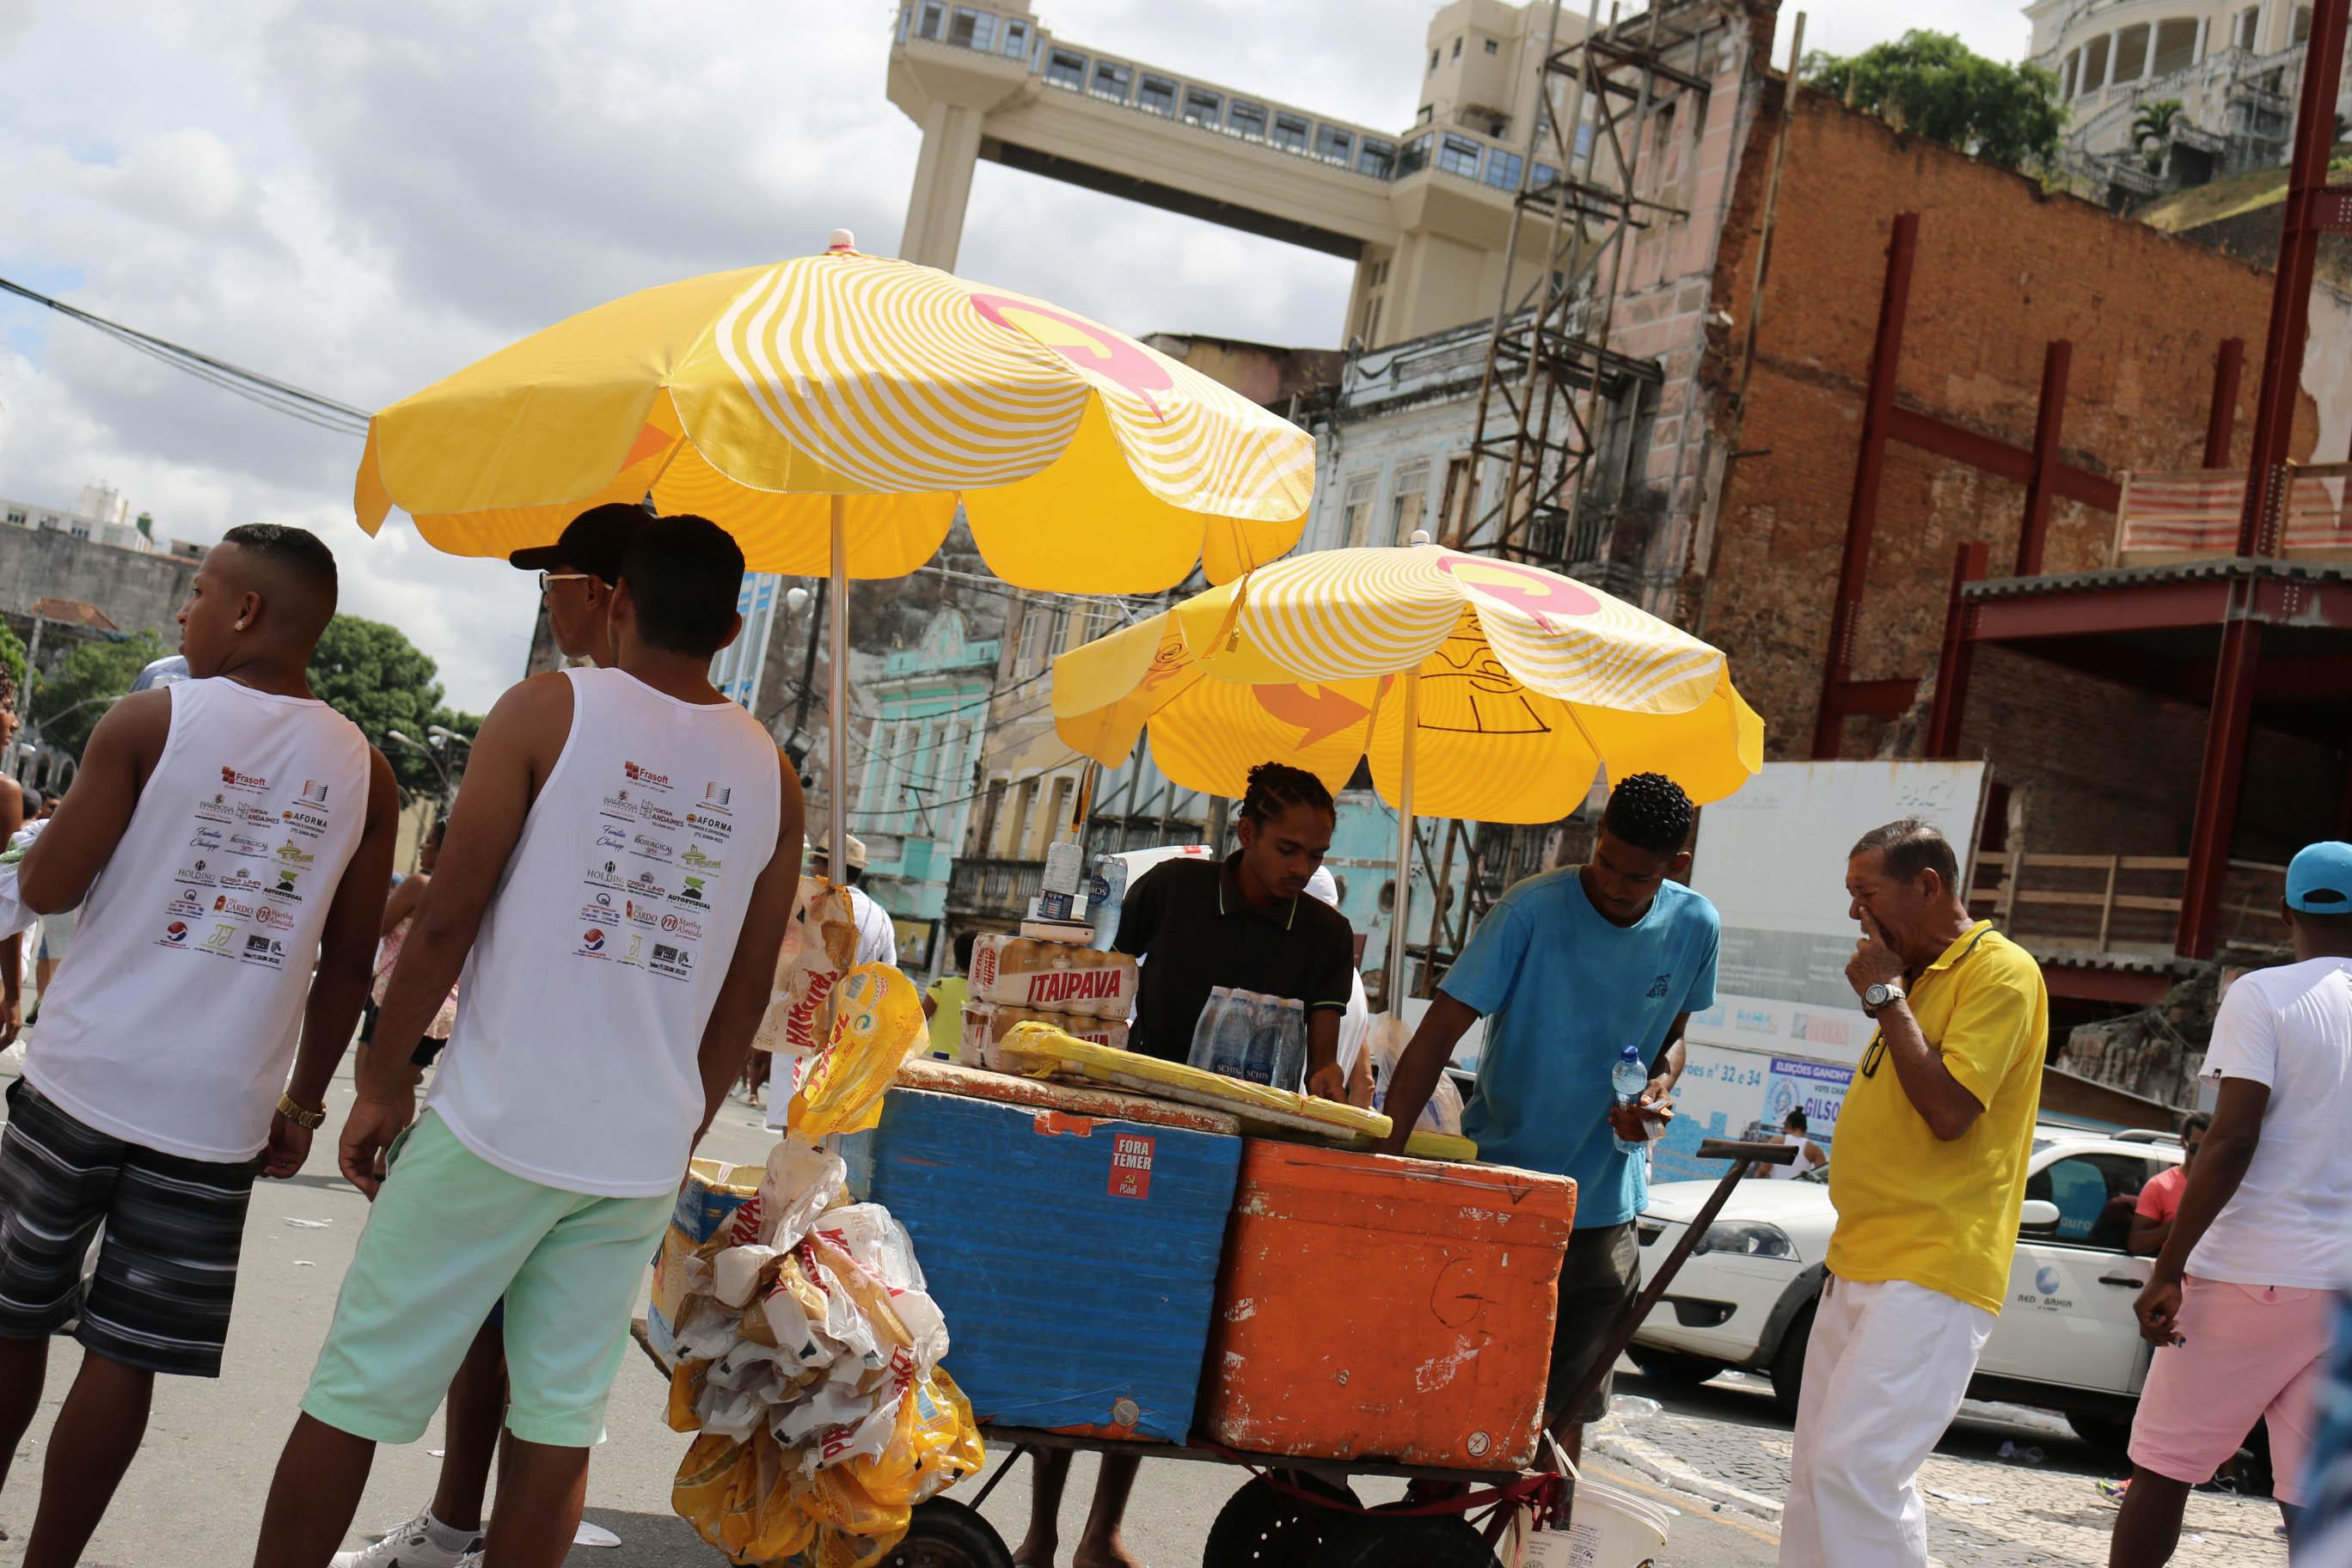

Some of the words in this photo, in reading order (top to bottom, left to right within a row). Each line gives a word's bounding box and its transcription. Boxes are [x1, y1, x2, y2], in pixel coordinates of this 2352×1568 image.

[236, 773, 266, 787] Frasoft
[640, 769, 668, 784] Frasoft
[248, 813, 280, 824] ANDAIMES
[293, 812, 328, 828] AFORMA
[652, 814, 684, 827] ANDAIMES
[697, 817, 732, 832] AFORMA
[178, 868, 216, 881] HOLDING
[226, 903, 254, 915] CARDO
[633, 910, 658, 922] CARDO
[678, 917, 701, 930] Martha
[1026, 970, 1121, 1003] ITAIPAVA
[1246, 1069, 1270, 1081] SCHIN
[1721, 1065, 1736, 1082] 32
[1738, 1073, 1744, 1084] e
[1747, 1069, 1761, 1087] 34
[1119, 1139, 1149, 1155] FORA
[1113, 1153, 1153, 1170] TEMER
